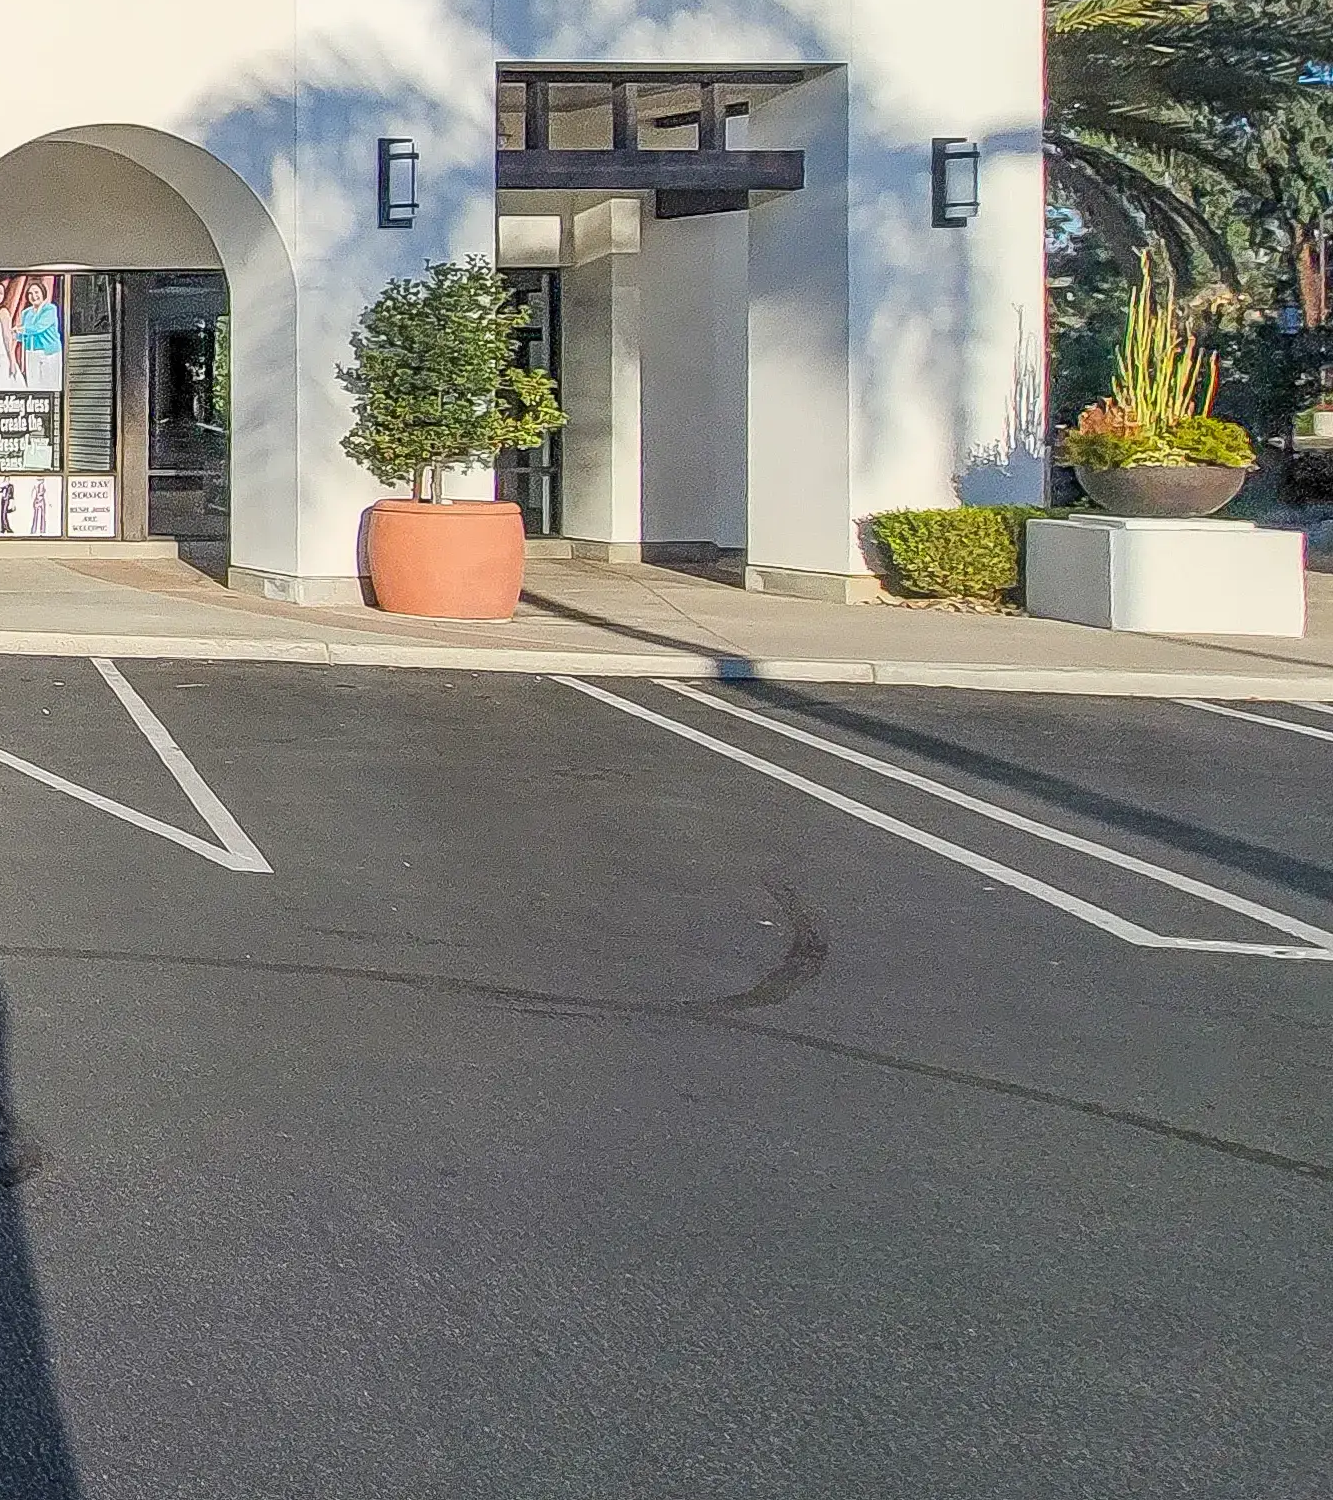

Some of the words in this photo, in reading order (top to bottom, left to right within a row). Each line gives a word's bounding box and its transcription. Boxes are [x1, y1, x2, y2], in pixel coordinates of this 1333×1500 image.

[26, 394, 50, 413] dress
[1, 416, 28, 432] create
[29, 414, 43, 432] the
